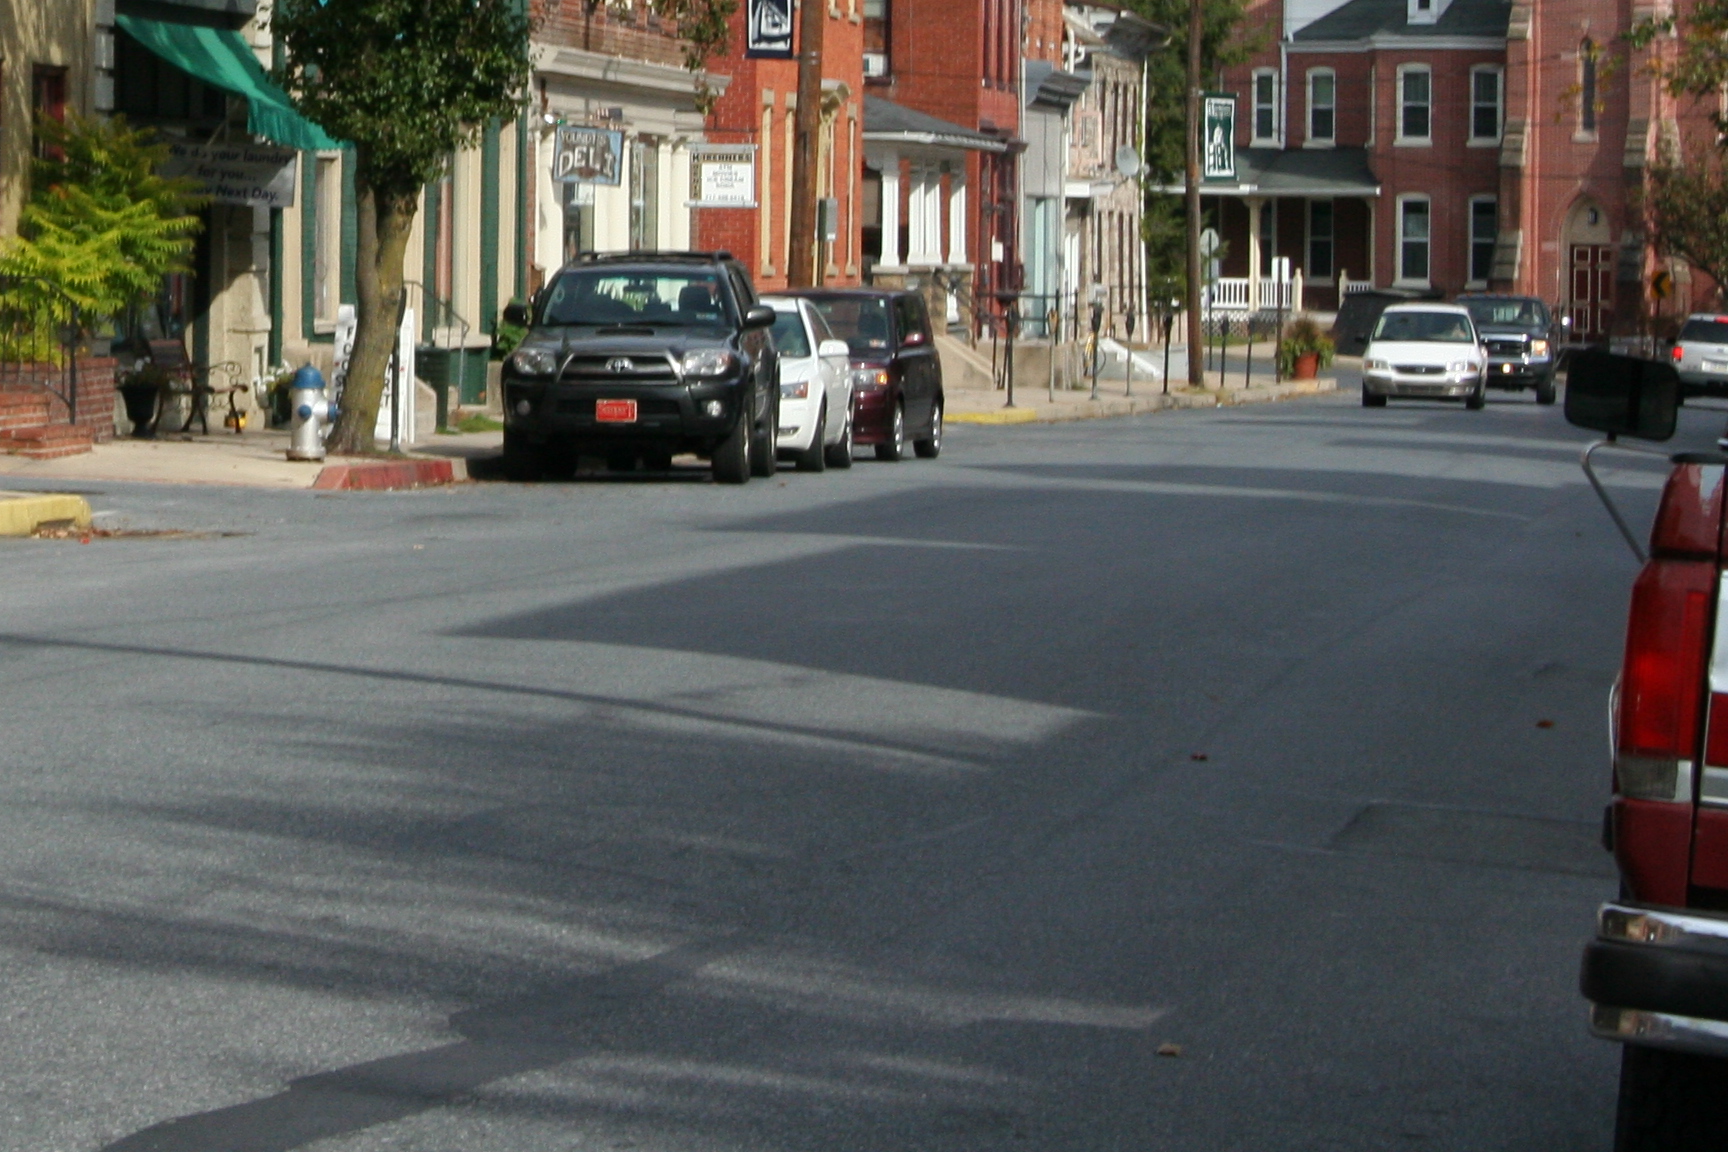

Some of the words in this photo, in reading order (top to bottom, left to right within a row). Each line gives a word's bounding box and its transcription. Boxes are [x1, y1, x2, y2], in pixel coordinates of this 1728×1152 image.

[212, 149, 240, 162] your
[244, 148, 292, 165] laundry
[558, 145, 613, 179] DELI
[198, 165, 215, 178] for
[216, 185, 247, 198] Next
[251, 186, 278, 204] Day.
